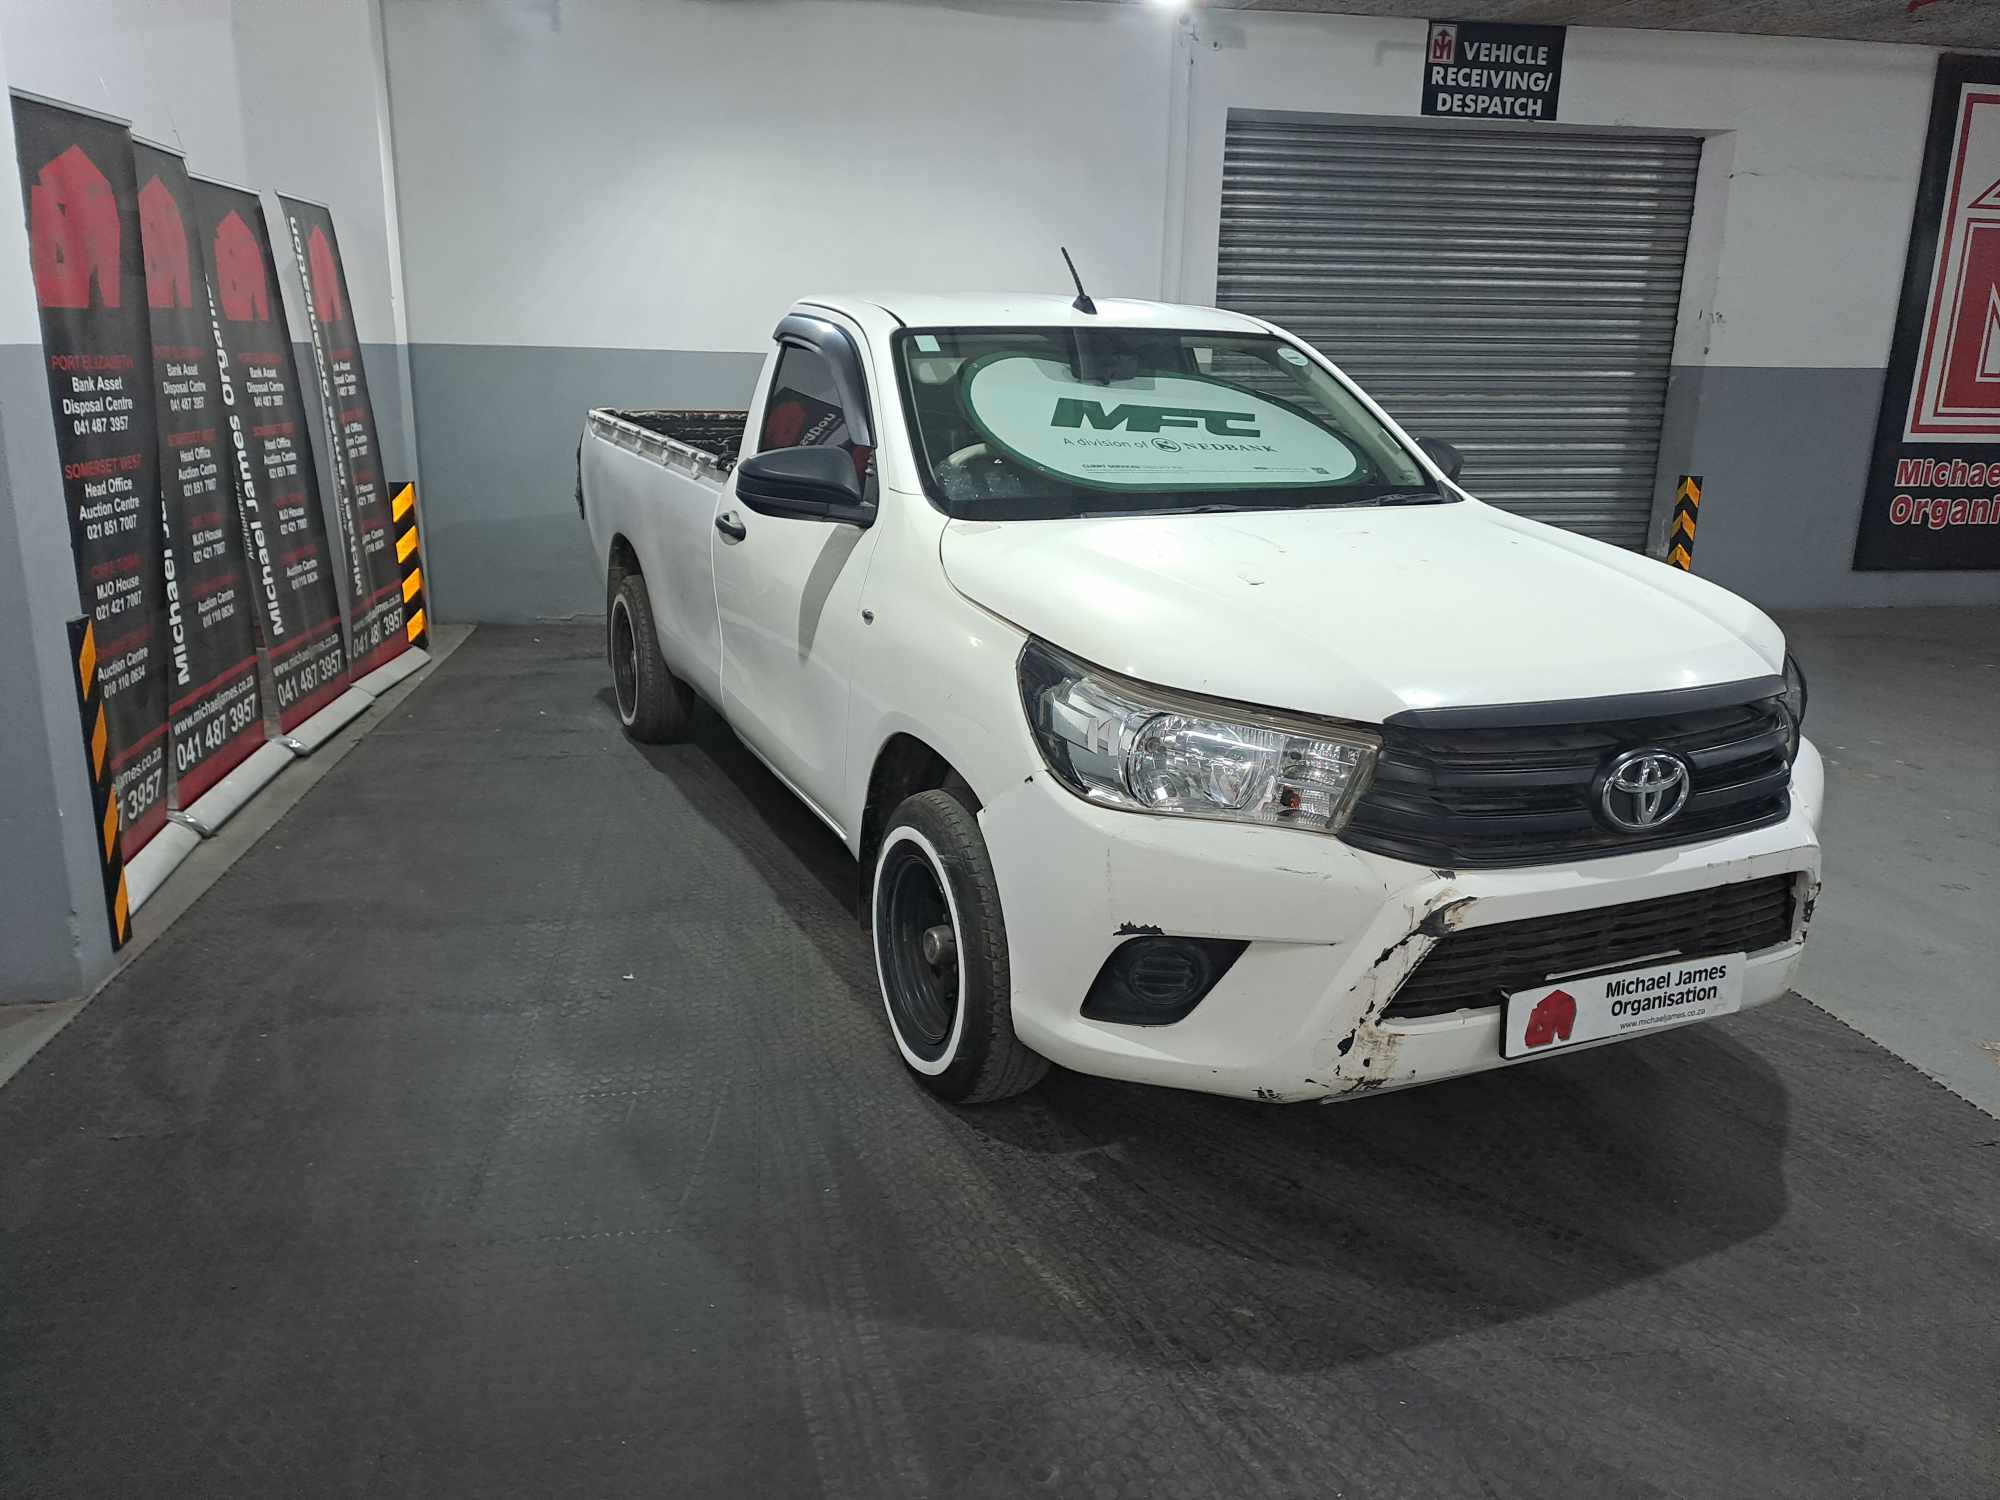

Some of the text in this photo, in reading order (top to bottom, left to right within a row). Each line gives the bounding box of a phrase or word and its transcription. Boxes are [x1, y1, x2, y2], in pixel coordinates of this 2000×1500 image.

[1464, 41, 1549, 66] VEHICLE
[1431, 66, 1553, 92] RECEIVING/
[1436, 92, 1543, 117] DESPATCH
[72, 376, 123, 392] Bank Asset
[63, 396, 133, 416] Disposal Centre
[1051, 397, 1261, 438] MFC
[74, 416, 129, 435] 041 487 3957
[1063, 437, 1278, 453] A division of NEDBANK
[85, 477, 133, 498] Head Office
[80, 496, 140, 520] Auction Centre
[87, 514, 137, 540] 021 851 7007
[229, 415, 285, 637] Michael James
[116, 575, 139, 592] House
[96, 603, 110, 620] 021
[111, 596, 125, 614] 421
[164, 549, 190, 686] Michael
[353, 632, 368, 658] 041
[97, 658, 125, 681] Auction
[277, 649, 342, 707] 041 487 3957
[177, 693, 256, 771] 041 487 3957
[127, 768, 163, 820] 3957
[1606, 965, 1727, 999] Michael James
[1611, 985, 1718, 1017] Organisation
